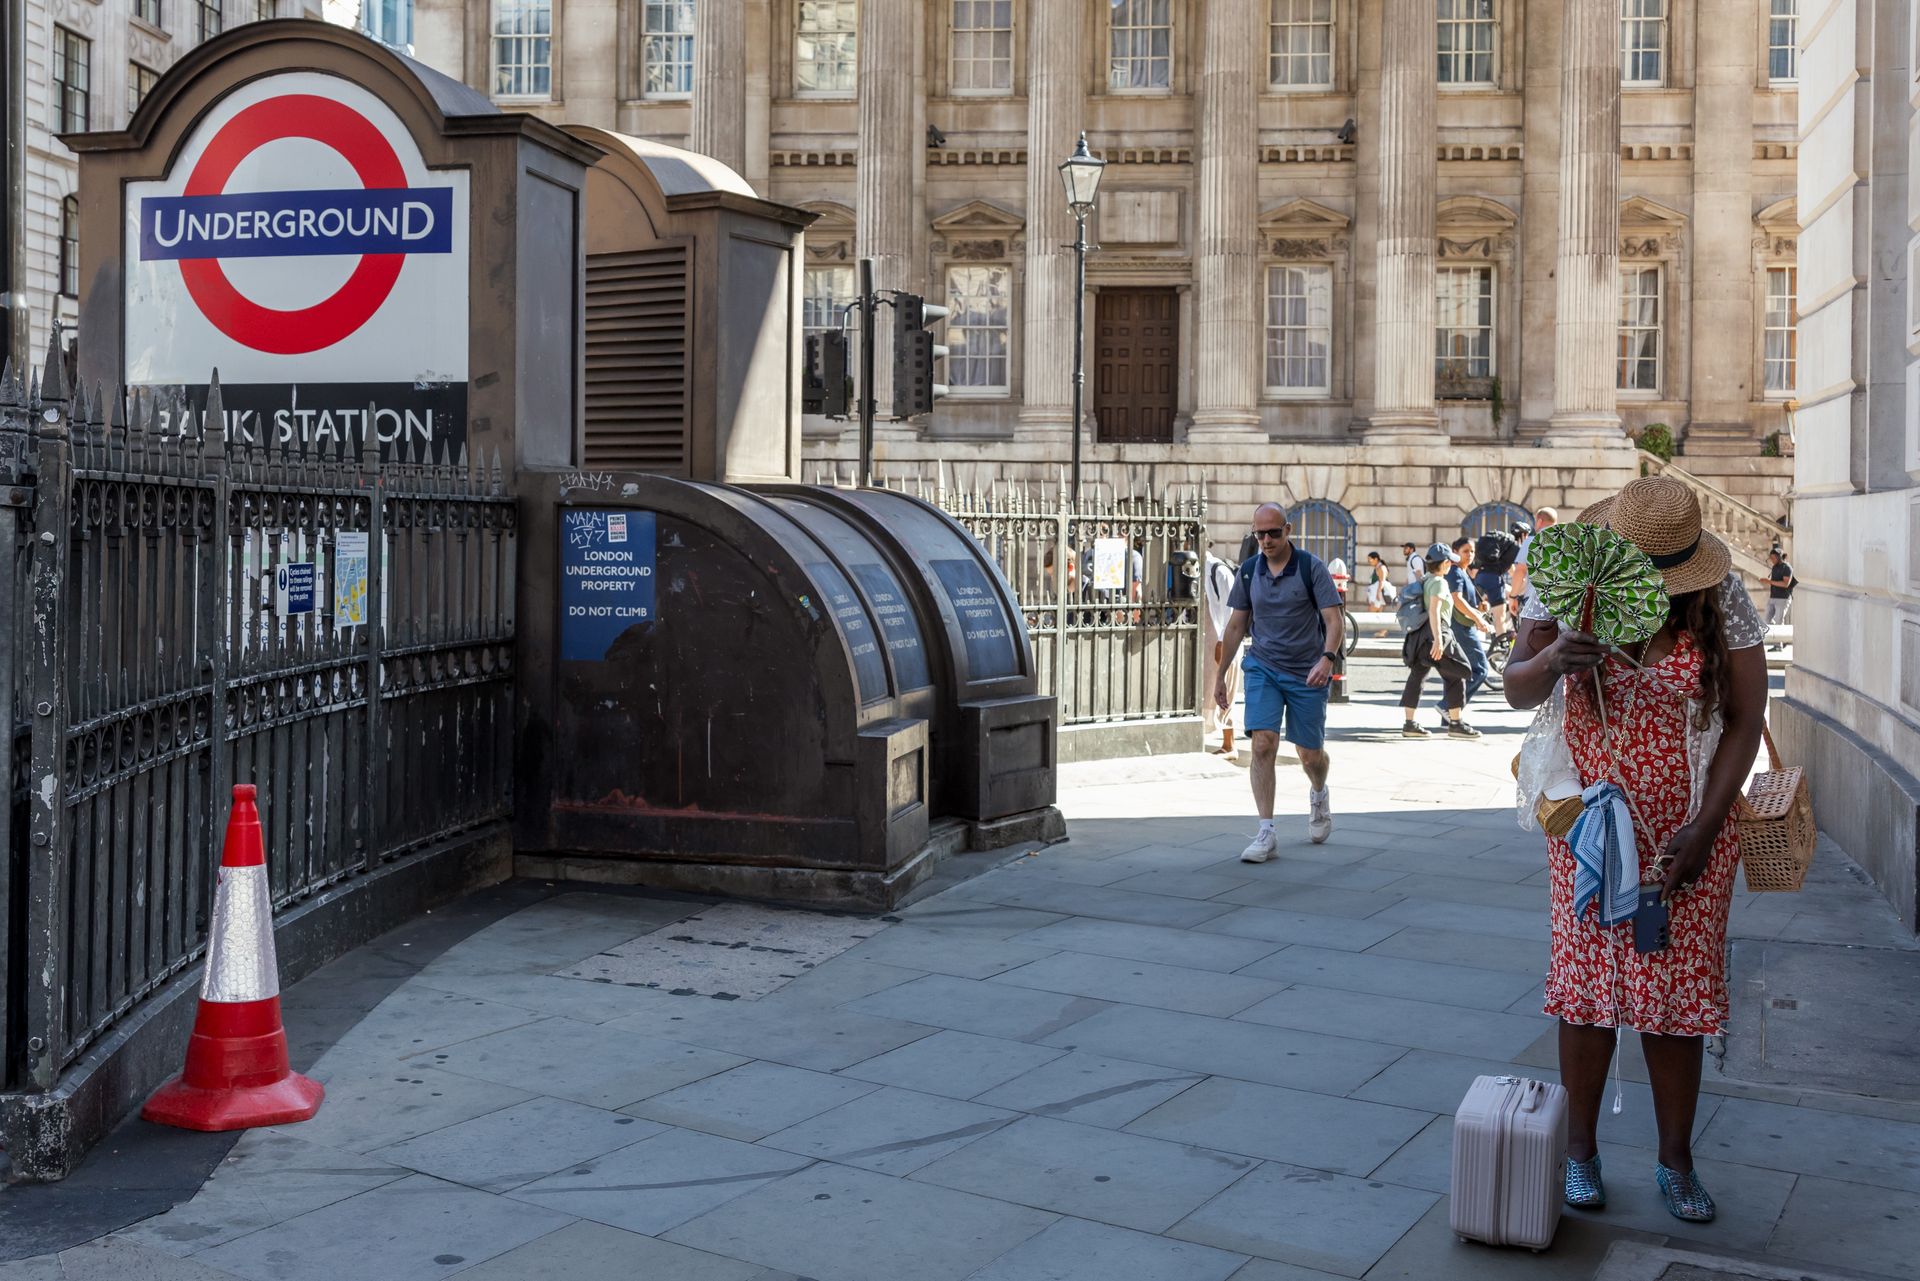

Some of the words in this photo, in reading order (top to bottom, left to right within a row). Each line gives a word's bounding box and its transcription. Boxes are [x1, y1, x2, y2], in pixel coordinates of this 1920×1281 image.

[154, 201, 435, 247] UNDERGROUND
[274, 408, 433, 442] STATION
[584, 551, 633, 561] LONDON
[566, 566, 651, 576] UNDERGROUND
[581, 580, 636, 591] PROPERTY
[569, 606, 586, 616] DO
[588, 606, 613, 616] NOT
[615, 607, 648, 617] CLIMB
